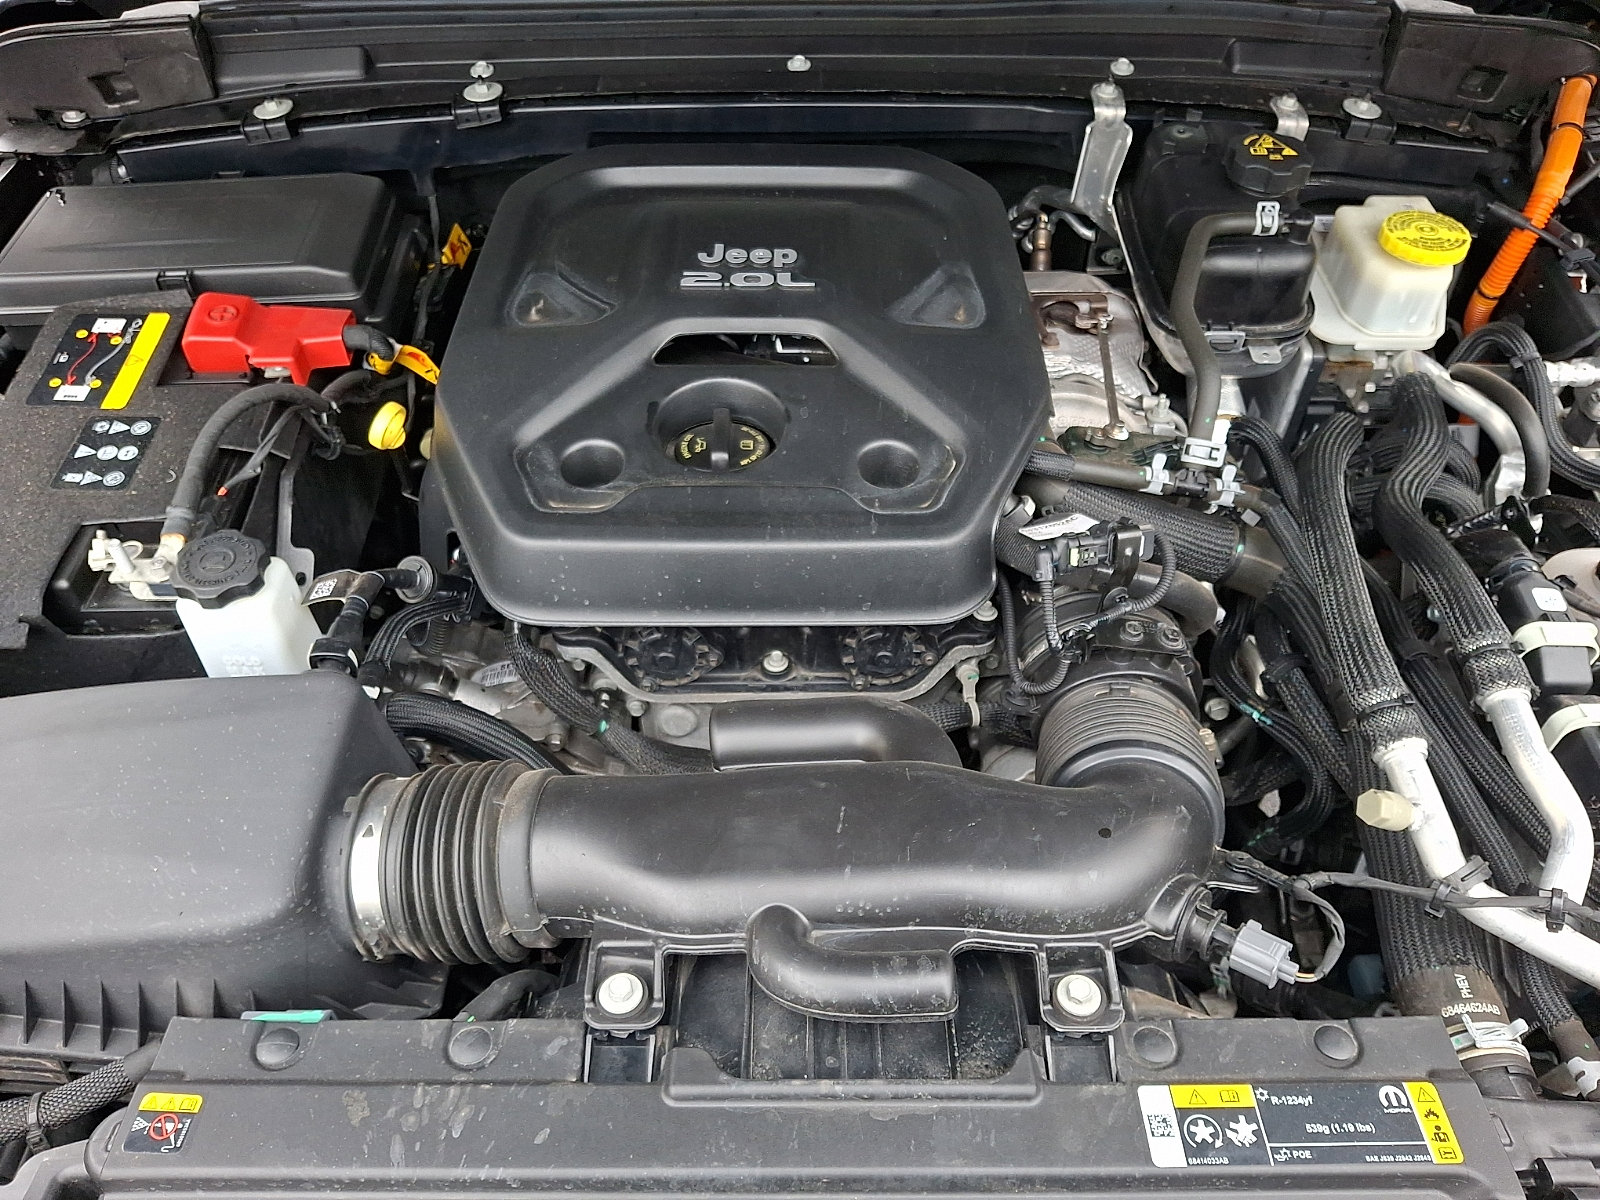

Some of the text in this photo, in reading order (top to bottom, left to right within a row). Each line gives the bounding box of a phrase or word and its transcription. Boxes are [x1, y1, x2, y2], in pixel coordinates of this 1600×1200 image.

[697, 243, 798, 268] Jeep
[680, 271, 816, 287] 2.0L
[1454, 973, 1474, 999] PHEV
[1270, 1095, 1313, 1107] R-1234yf
[1356, 1122, 1376, 1134] lbs)
[1293, 1151, 1312, 1159] POE
